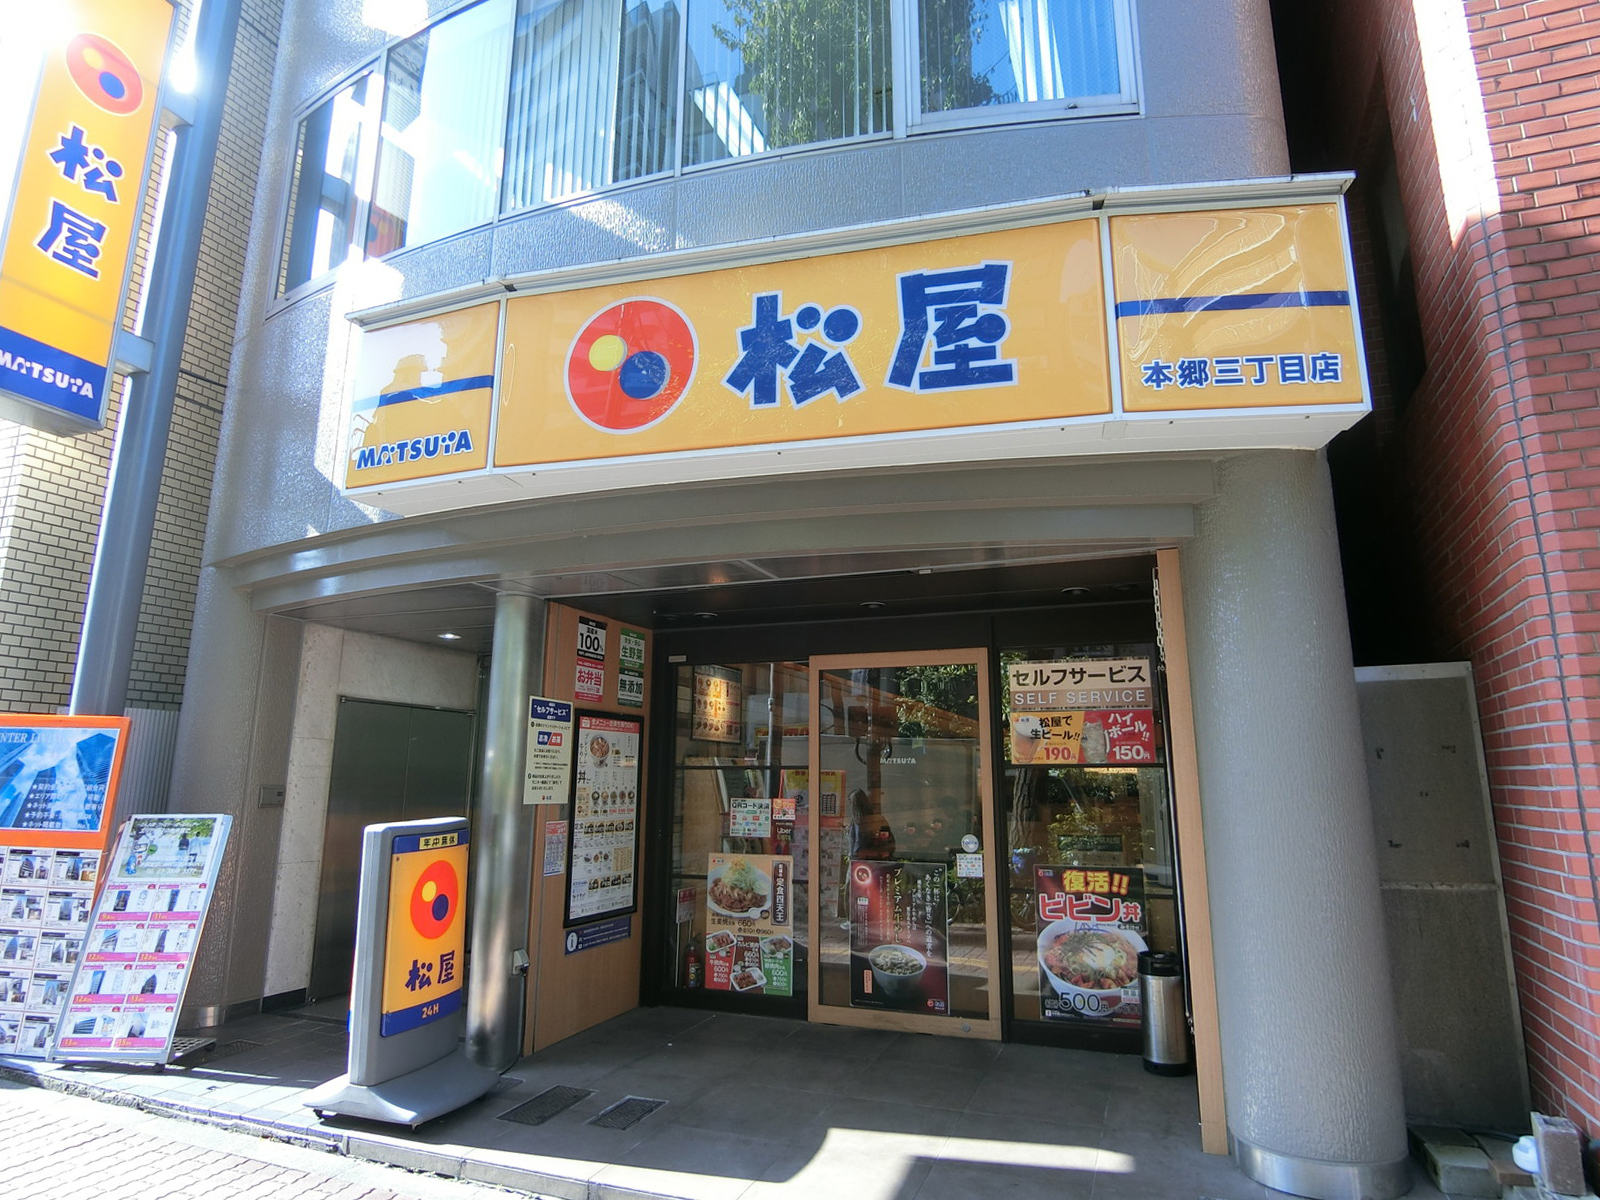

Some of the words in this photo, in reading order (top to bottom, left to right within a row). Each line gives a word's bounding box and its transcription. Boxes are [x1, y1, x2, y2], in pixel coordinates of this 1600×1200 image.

[36, 123, 126, 280] 松屋
[723, 261, 1018, 409] 松屋
[0, 349, 94, 399] MATSUYA
[1142, 353, 1341, 389] 本郷三丁目店
[355, 430, 474, 471] MATSUYA
[577, 668, 602, 686] お弁当
[1012, 665, 1146, 686] セルフサービス
[1014, 692, 1057, 705] SELF
[1066, 689, 1146, 704] SERVICE
[1039, 715, 1072, 728] 松屋で
[1108, 712, 1134, 725] ハイ
[423, 836, 456, 848] 年中無休
[1063, 869, 1131, 895] 復活!!
[893, 867, 903, 943] プレミアム牛めし
[1039, 892, 1141, 922] ビビン丼
[405, 950, 455, 991] 松屋
[421, 1003, 440, 1019] 24H
